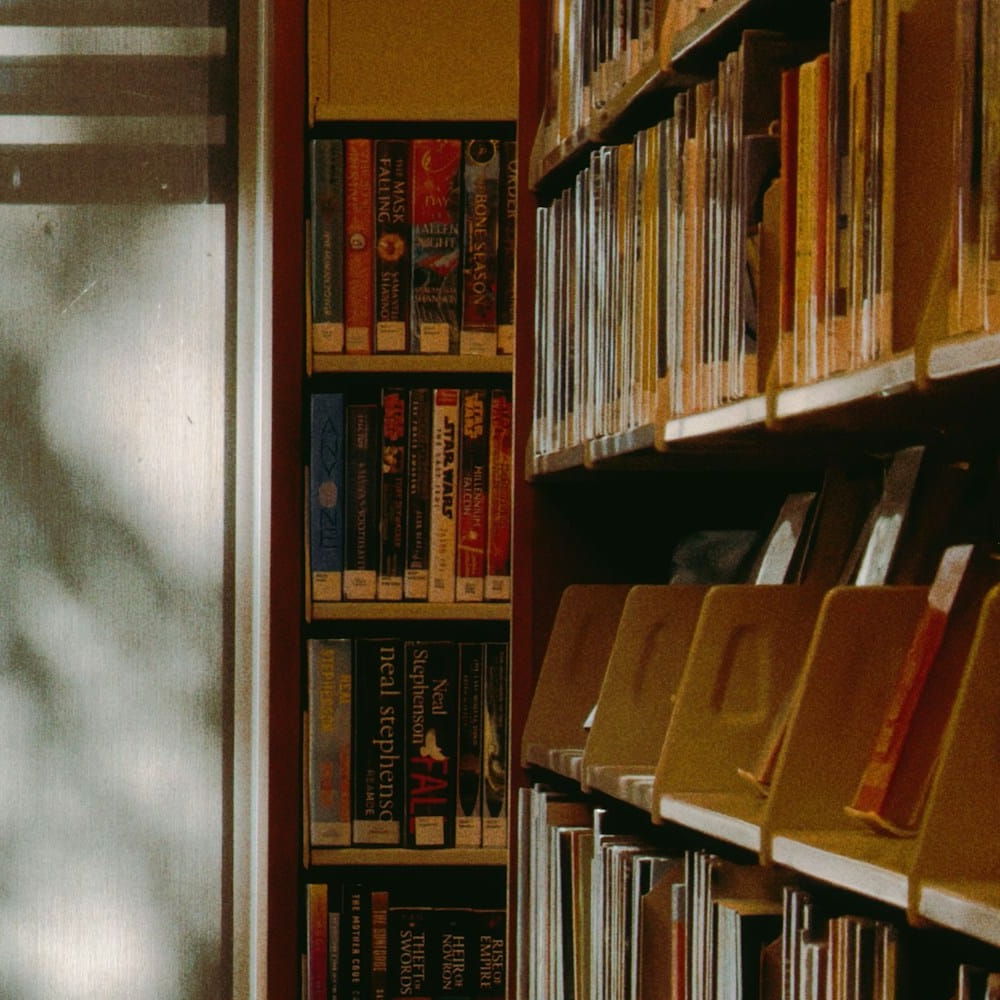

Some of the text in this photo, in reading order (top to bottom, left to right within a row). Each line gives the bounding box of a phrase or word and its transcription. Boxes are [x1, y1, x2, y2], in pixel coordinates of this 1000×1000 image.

[378, 158, 391, 223] FALLING
[392, 181, 405, 224] MASK
[425, 195, 449, 207] DAY
[473, 194, 488, 236] BONE
[472, 242, 487, 305] SEASON
[463, 394, 474, 440] WARS
[474, 392, 485, 438] STAR
[443, 416, 454, 467] STAR
[443, 469, 454, 519] WARS
[463, 476, 472, 516] FALCON
[472, 465, 483, 527] MILLENNIUM
[379, 646, 402, 696] neal
[409, 649, 428, 744] Stephenson
[431, 678, 449, 715] Neal
[372, 706, 400, 822] stephenso
[351, 959, 360, 983] CODE
[400, 930, 412, 995] SWORDS
[413, 933, 425, 980] THEFT
[442, 934, 452, 991] NOVRON
[453, 935, 465, 987] HEIR OF
[479, 935, 492, 989] EMPIRE
[492, 939, 504, 970] RISE
